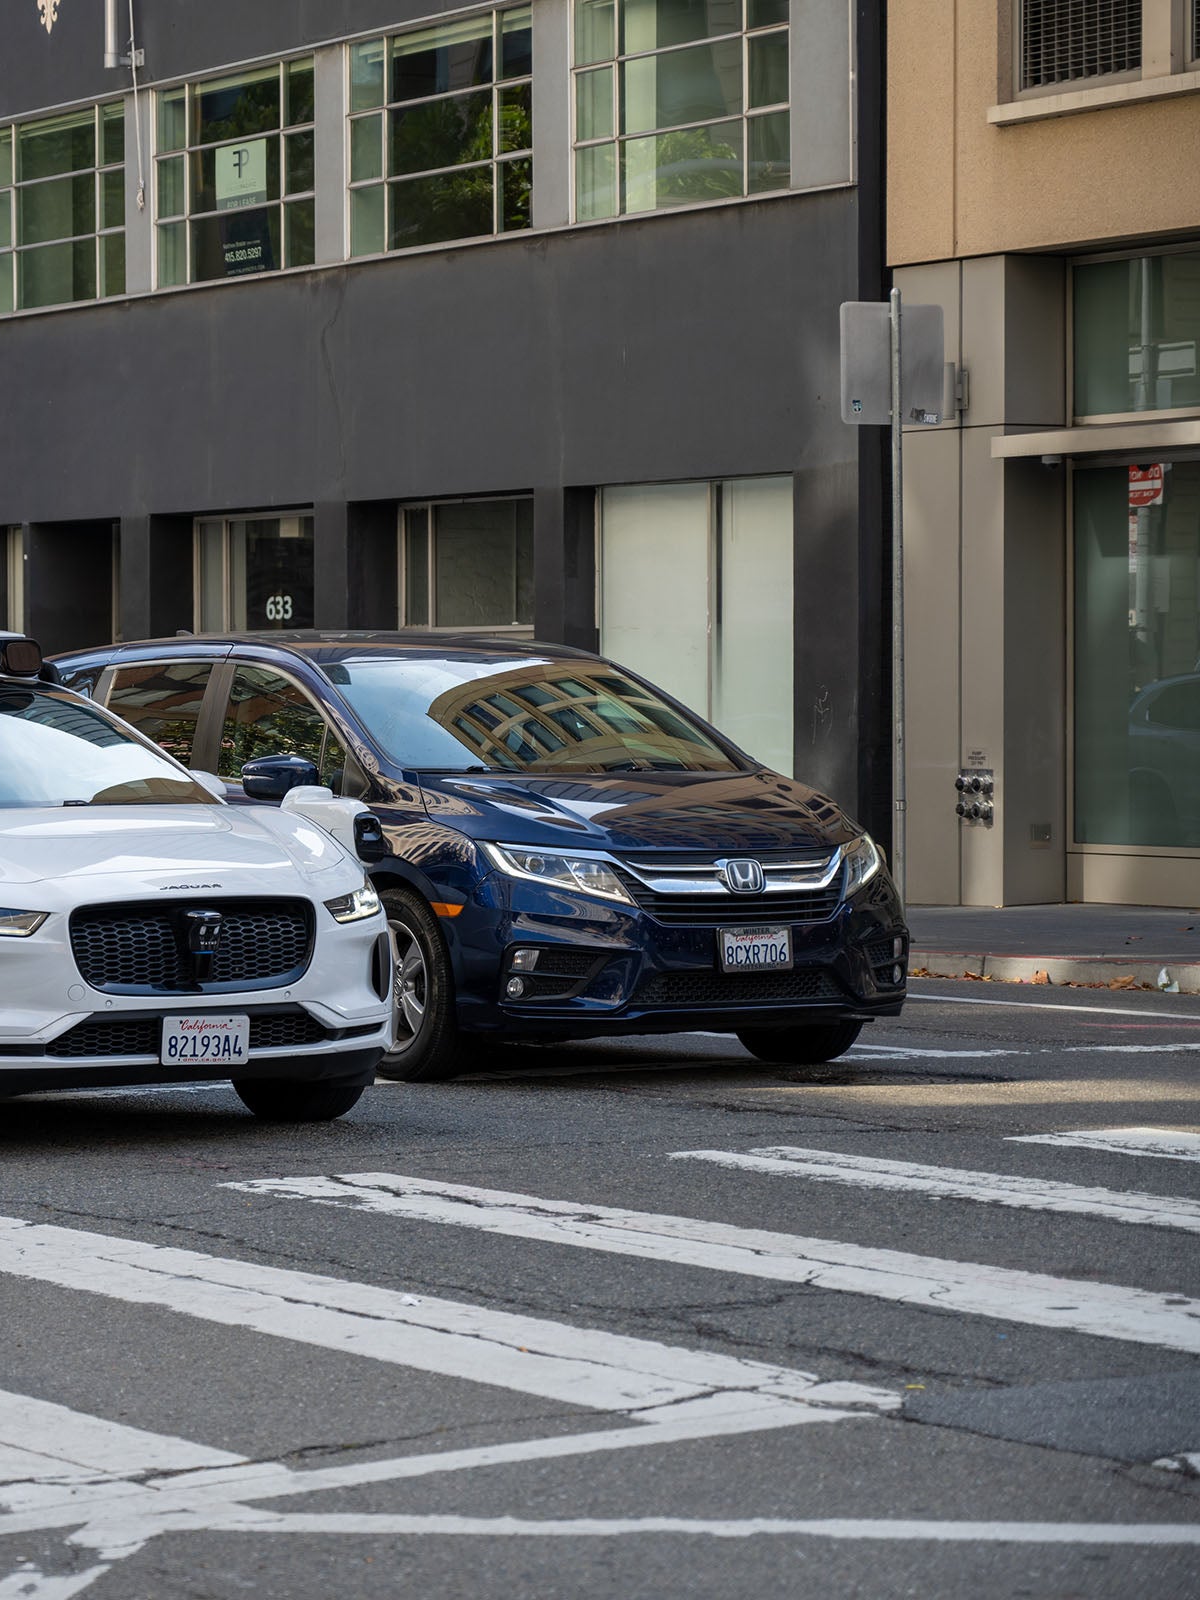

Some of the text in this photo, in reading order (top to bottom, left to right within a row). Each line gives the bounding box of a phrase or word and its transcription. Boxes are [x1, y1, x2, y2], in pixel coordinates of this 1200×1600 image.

[266, 595, 293, 620] 633
[159, 883, 223, 891] JAGUAR
[735, 934, 777, 944] California
[726, 943, 787, 965] 8CXR706
[180, 1019, 233, 1034] California
[168, 1035, 243, 1058] 82193A4
